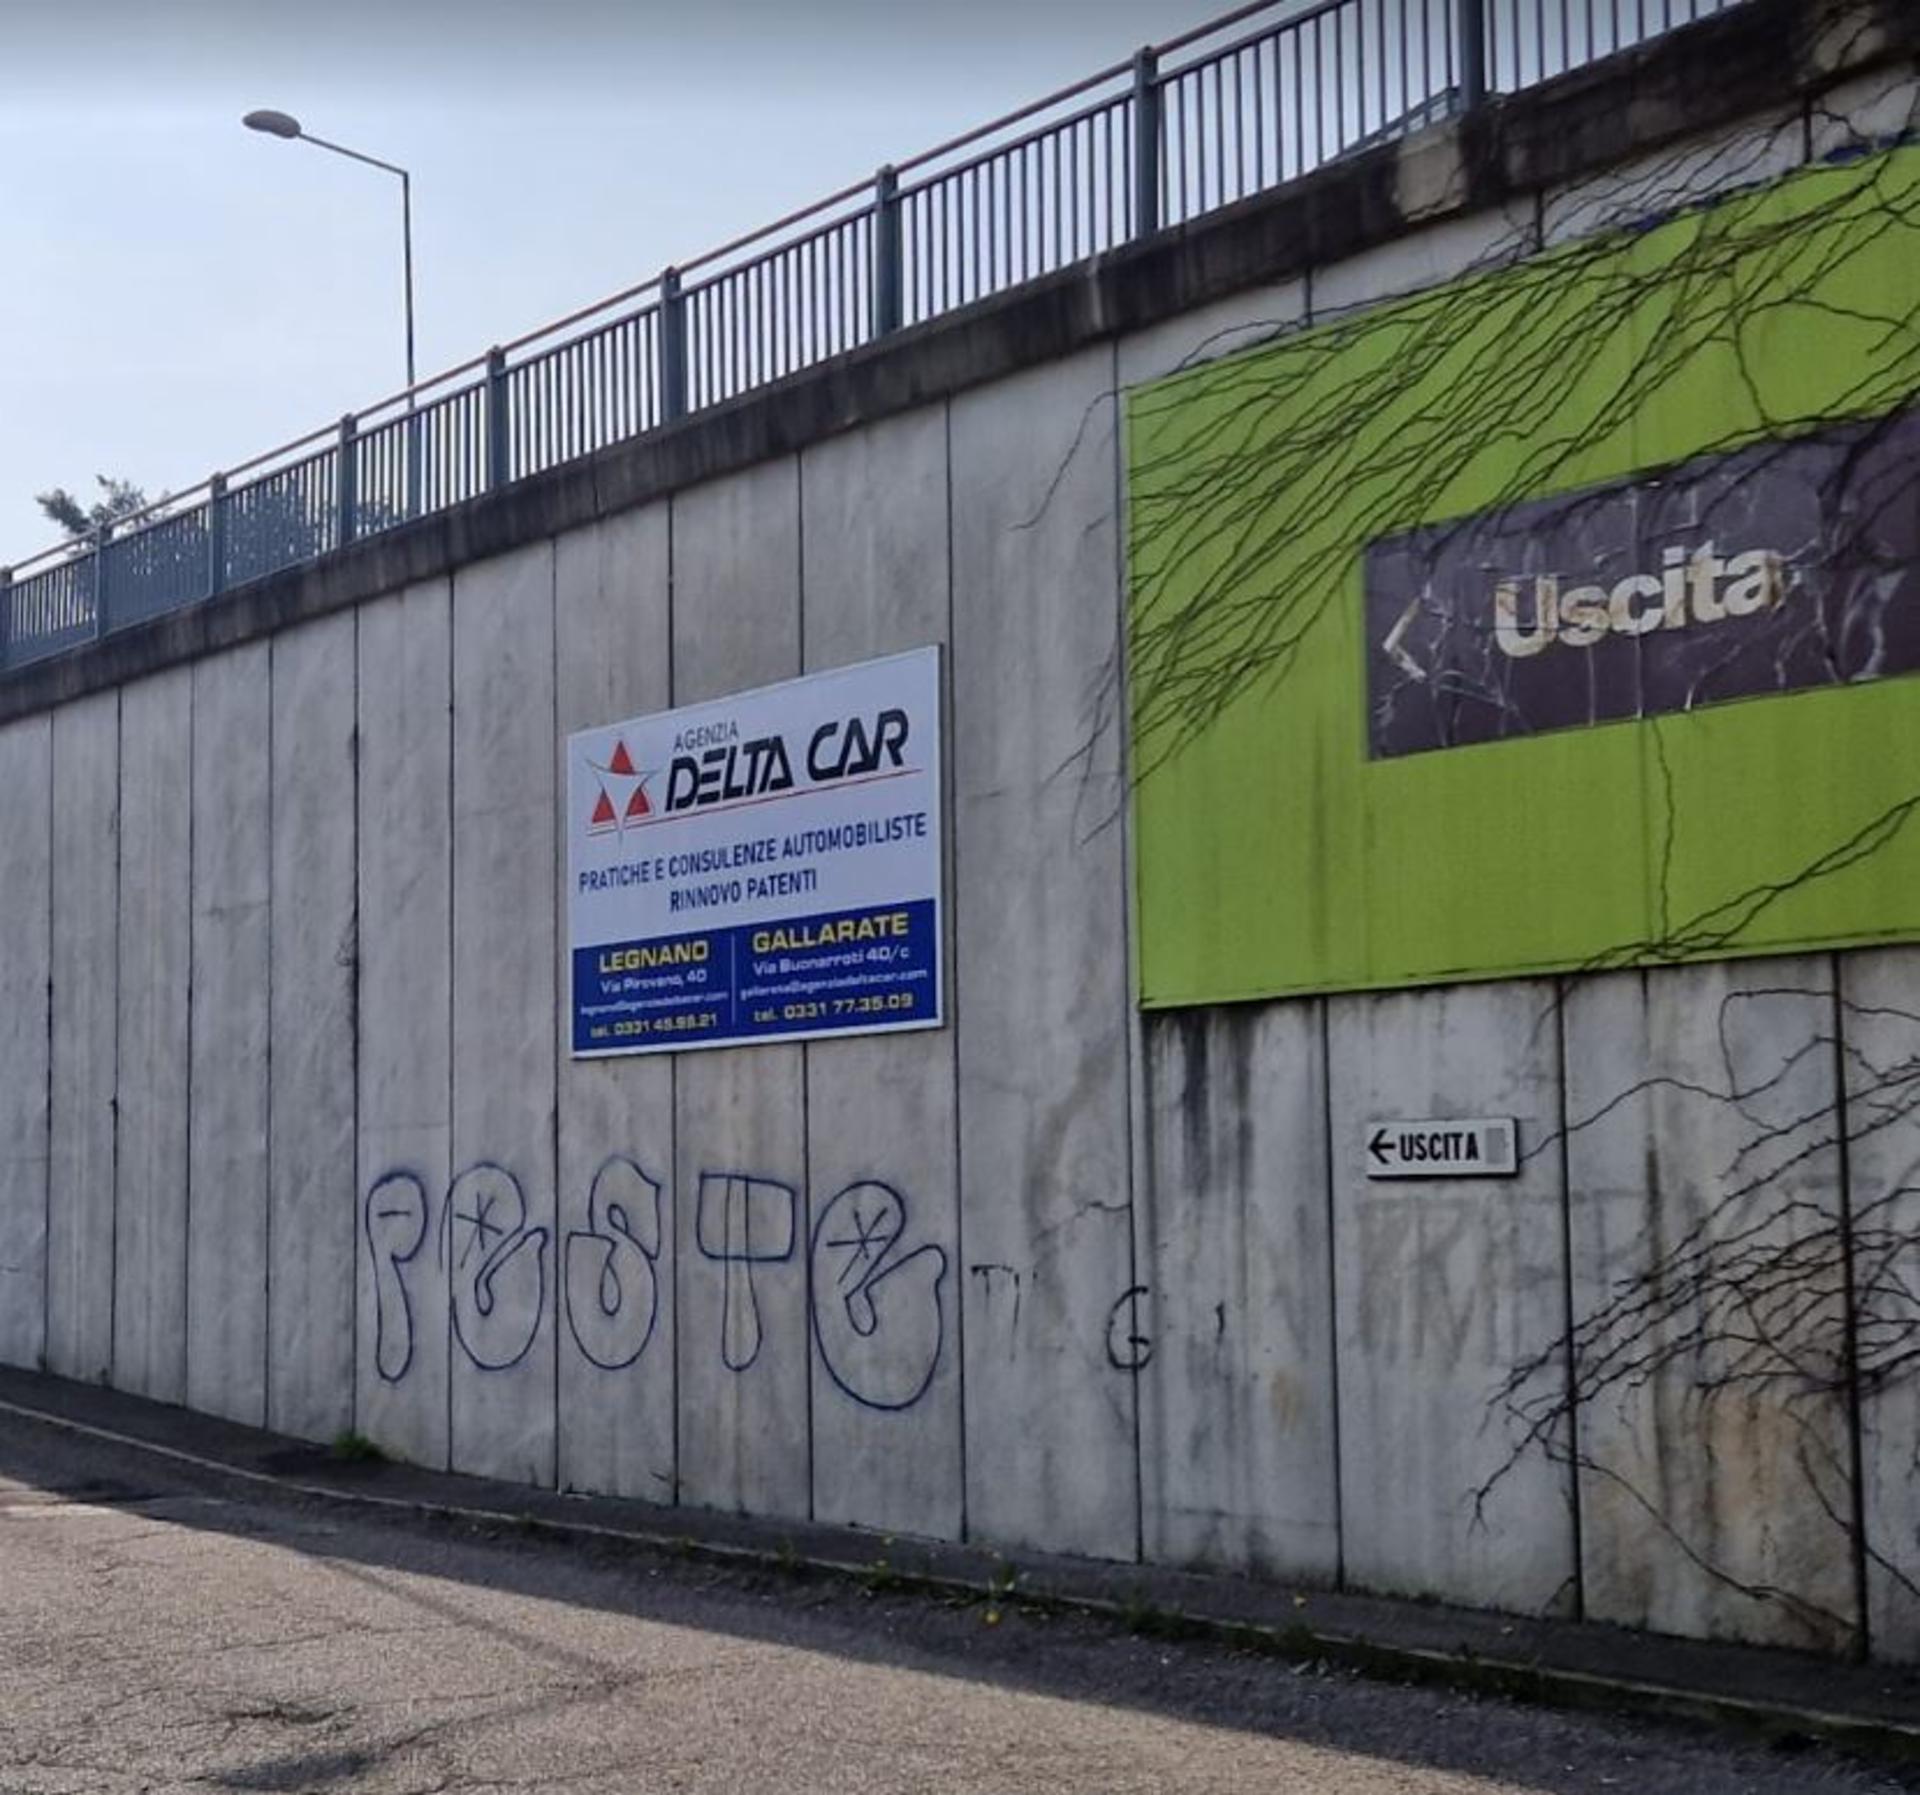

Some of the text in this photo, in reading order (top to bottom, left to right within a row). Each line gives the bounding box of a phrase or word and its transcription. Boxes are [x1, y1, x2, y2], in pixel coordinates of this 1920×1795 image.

[1494, 540, 1782, 657] Uscita
[673, 721, 739, 752] AGENZIA
[664, 708, 909, 812] DELTA CAR
[579, 812, 927, 893] PRATICHE E CONSULENZE AUTOMOBILISTE
[670, 869, 817, 912] RINNOVO PATENTI
[753, 913, 909, 953] GALLARATE
[600, 940, 709, 973] LEGNANO
[754, 945, 909, 976] Via Buonarroti 40/c
[601, 980, 621, 994] Via
[686, 969, 707, 983] 40
[754, 1008, 778, 1022] tel.
[784, 1002, 828, 1019] 0331
[1400, 1132, 1479, 1161] USCITA
